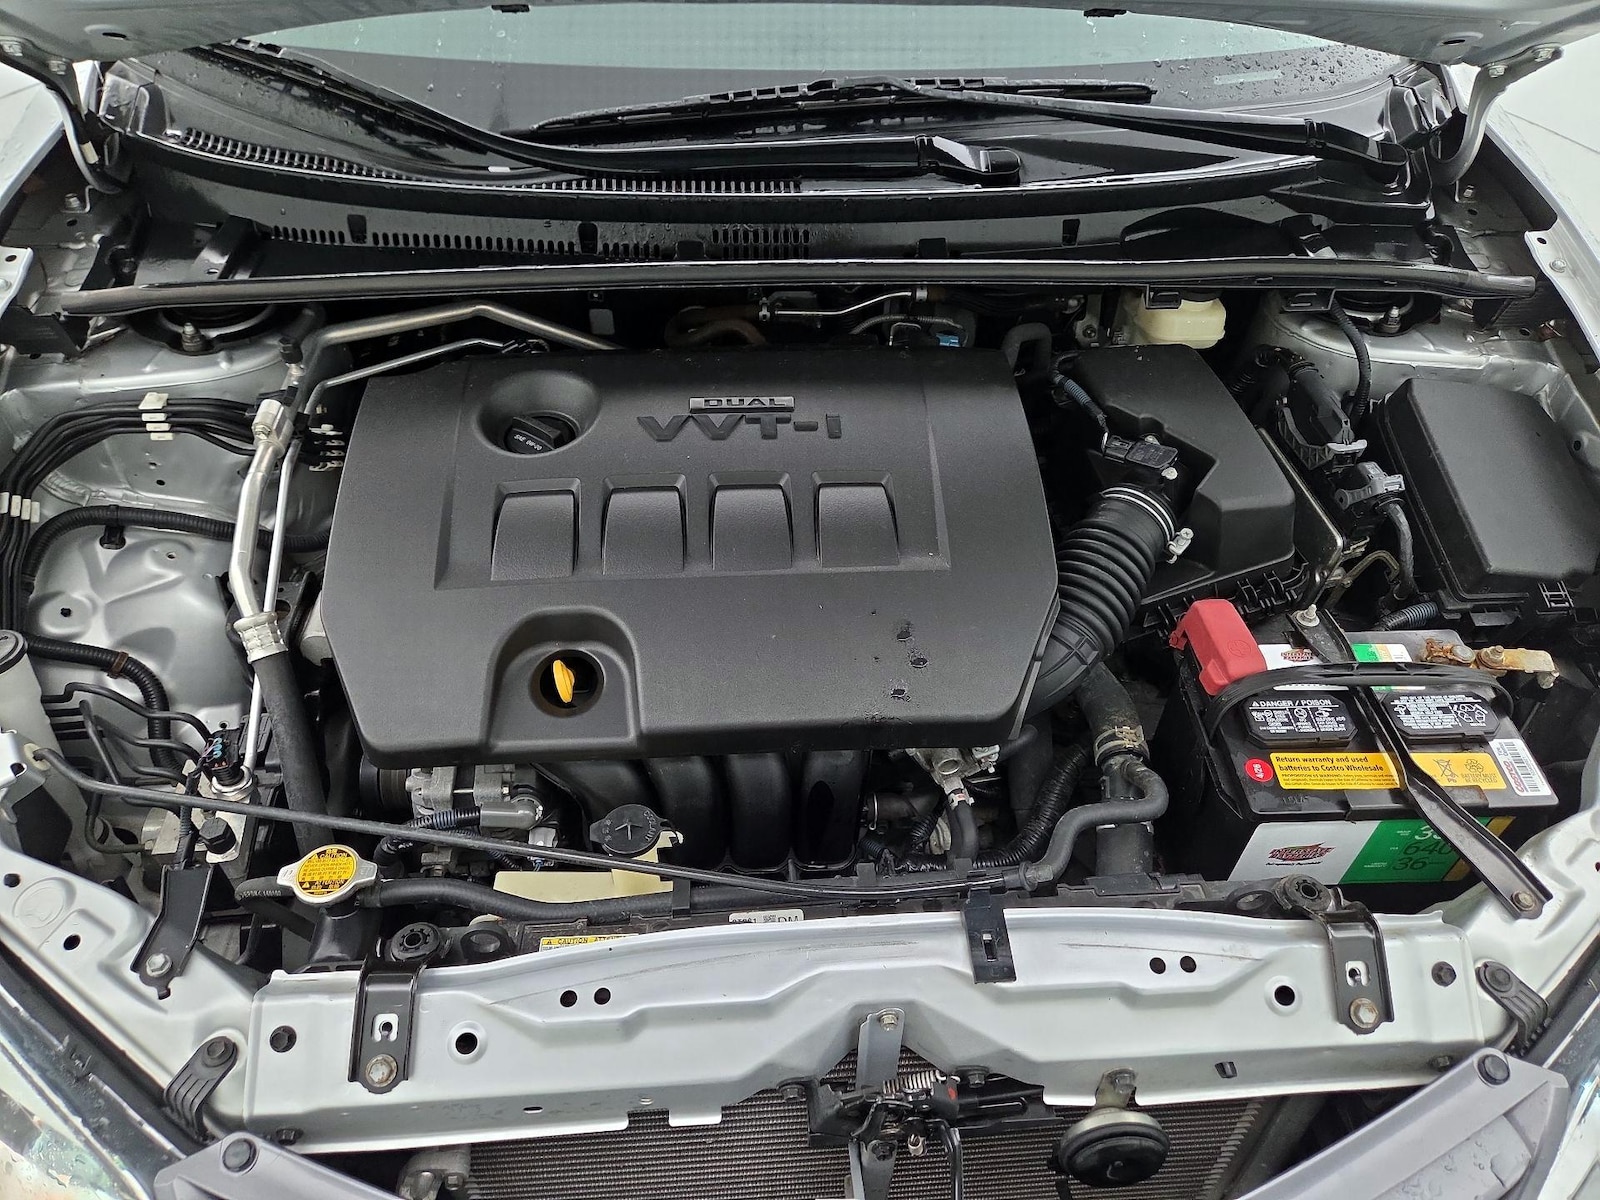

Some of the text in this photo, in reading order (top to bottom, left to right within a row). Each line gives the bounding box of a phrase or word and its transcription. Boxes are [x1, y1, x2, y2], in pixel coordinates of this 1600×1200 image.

[703, 398, 787, 407] DUAL
[1301, 756, 1334, 764] warranty
[1320, 764, 1344, 772] Costco
[1344, 764, 1384, 772] Wholesale
[1393, 856, 1430, 871] 36
[557, 937, 588, 945] CAUTION
